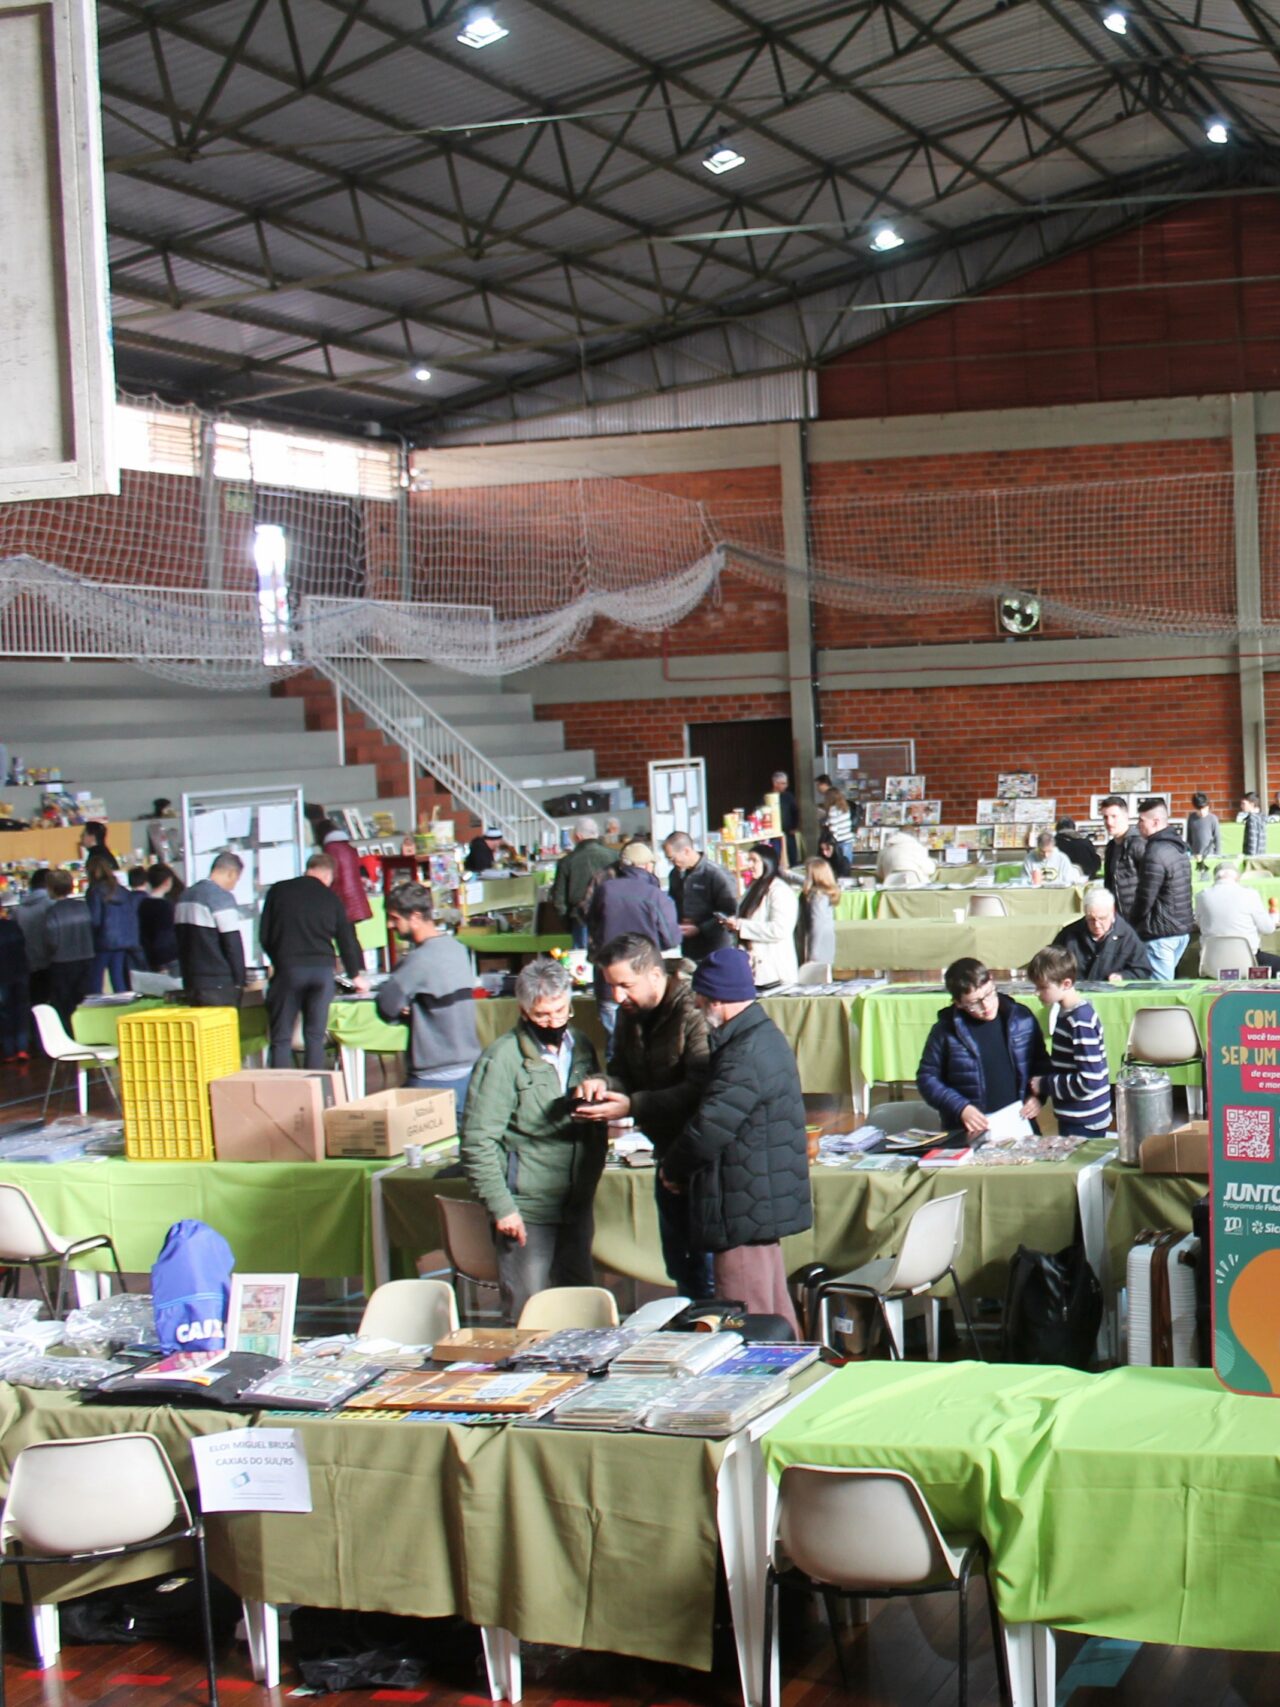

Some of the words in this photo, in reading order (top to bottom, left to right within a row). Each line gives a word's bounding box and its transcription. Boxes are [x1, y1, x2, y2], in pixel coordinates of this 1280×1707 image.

[1245, 1010, 1276, 1028] COM
[1247, 1032, 1266, 1041] você
[1221, 1046, 1249, 1065] SER
[1254, 1047, 1276, 1066] UM
[1251, 1070, 1261, 1078] de
[407, 1118, 443, 1138] GRANOLA
[1223, 1201, 1254, 1210] Programa
[176, 1319, 224, 1343] CAIX
[232, 1441, 266, 1449] MIGUEL
[216, 1457, 247, 1466] CAXIAS
[250, 1457, 263, 1465] DO
[264, 1457, 294, 1467] SUL/RS
